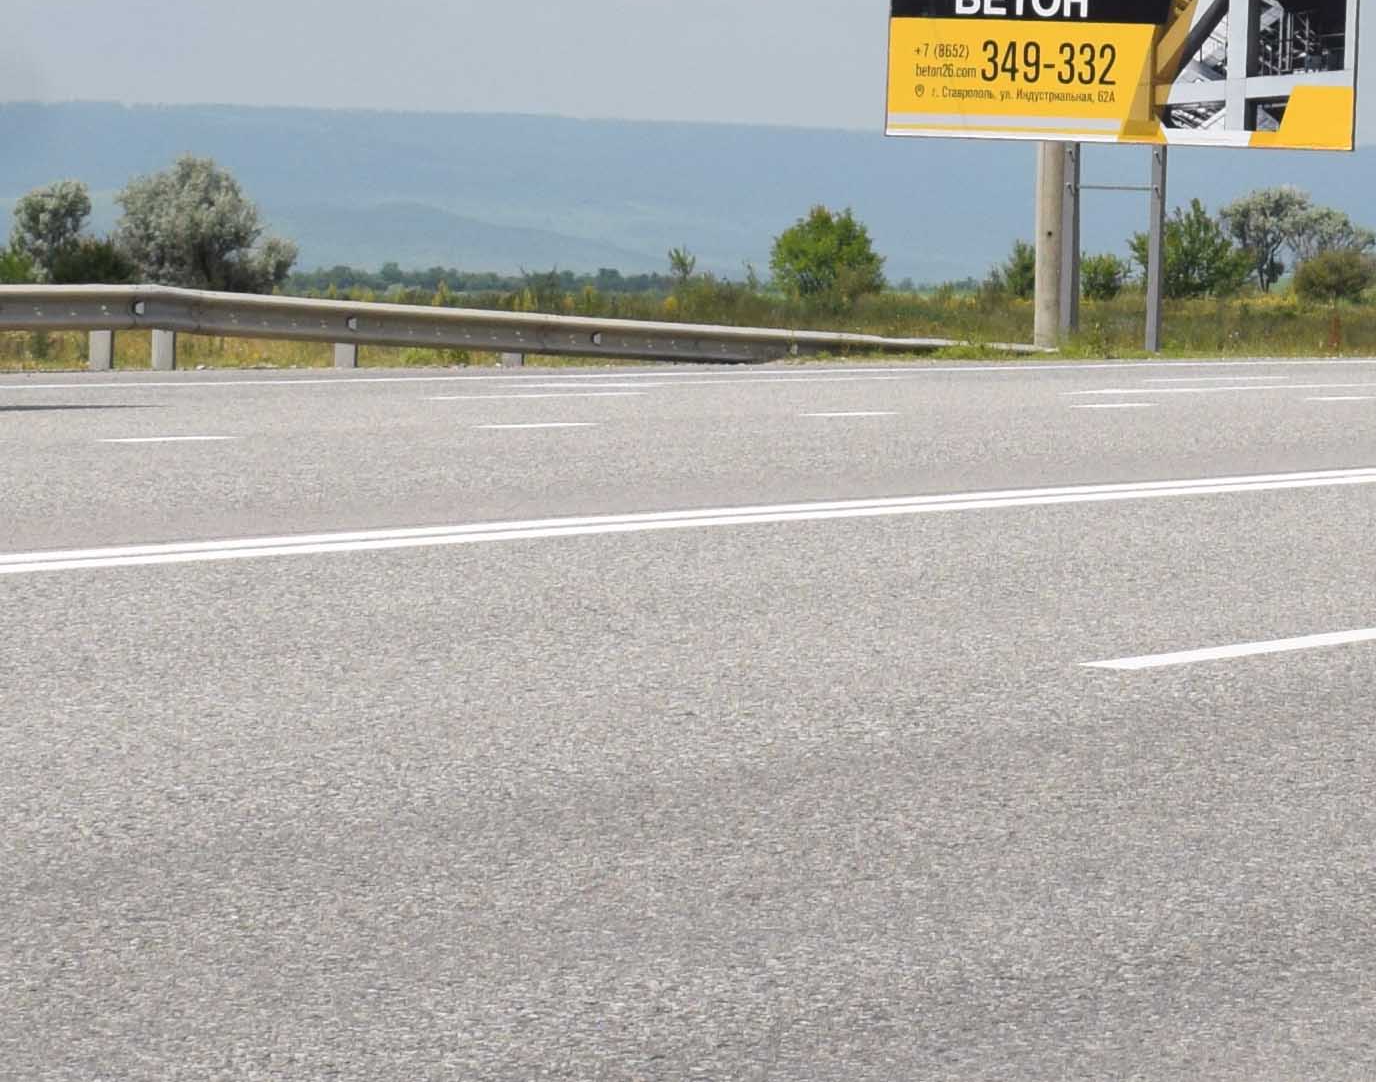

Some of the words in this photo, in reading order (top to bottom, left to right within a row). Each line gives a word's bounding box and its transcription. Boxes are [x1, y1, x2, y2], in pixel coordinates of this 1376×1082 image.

[914, 43, 930, 57] +7
[934, 43, 970, 61] (8652)
[915, 62, 977, 78] beton26.com
[981, 39, 1117, 85] 349-332
